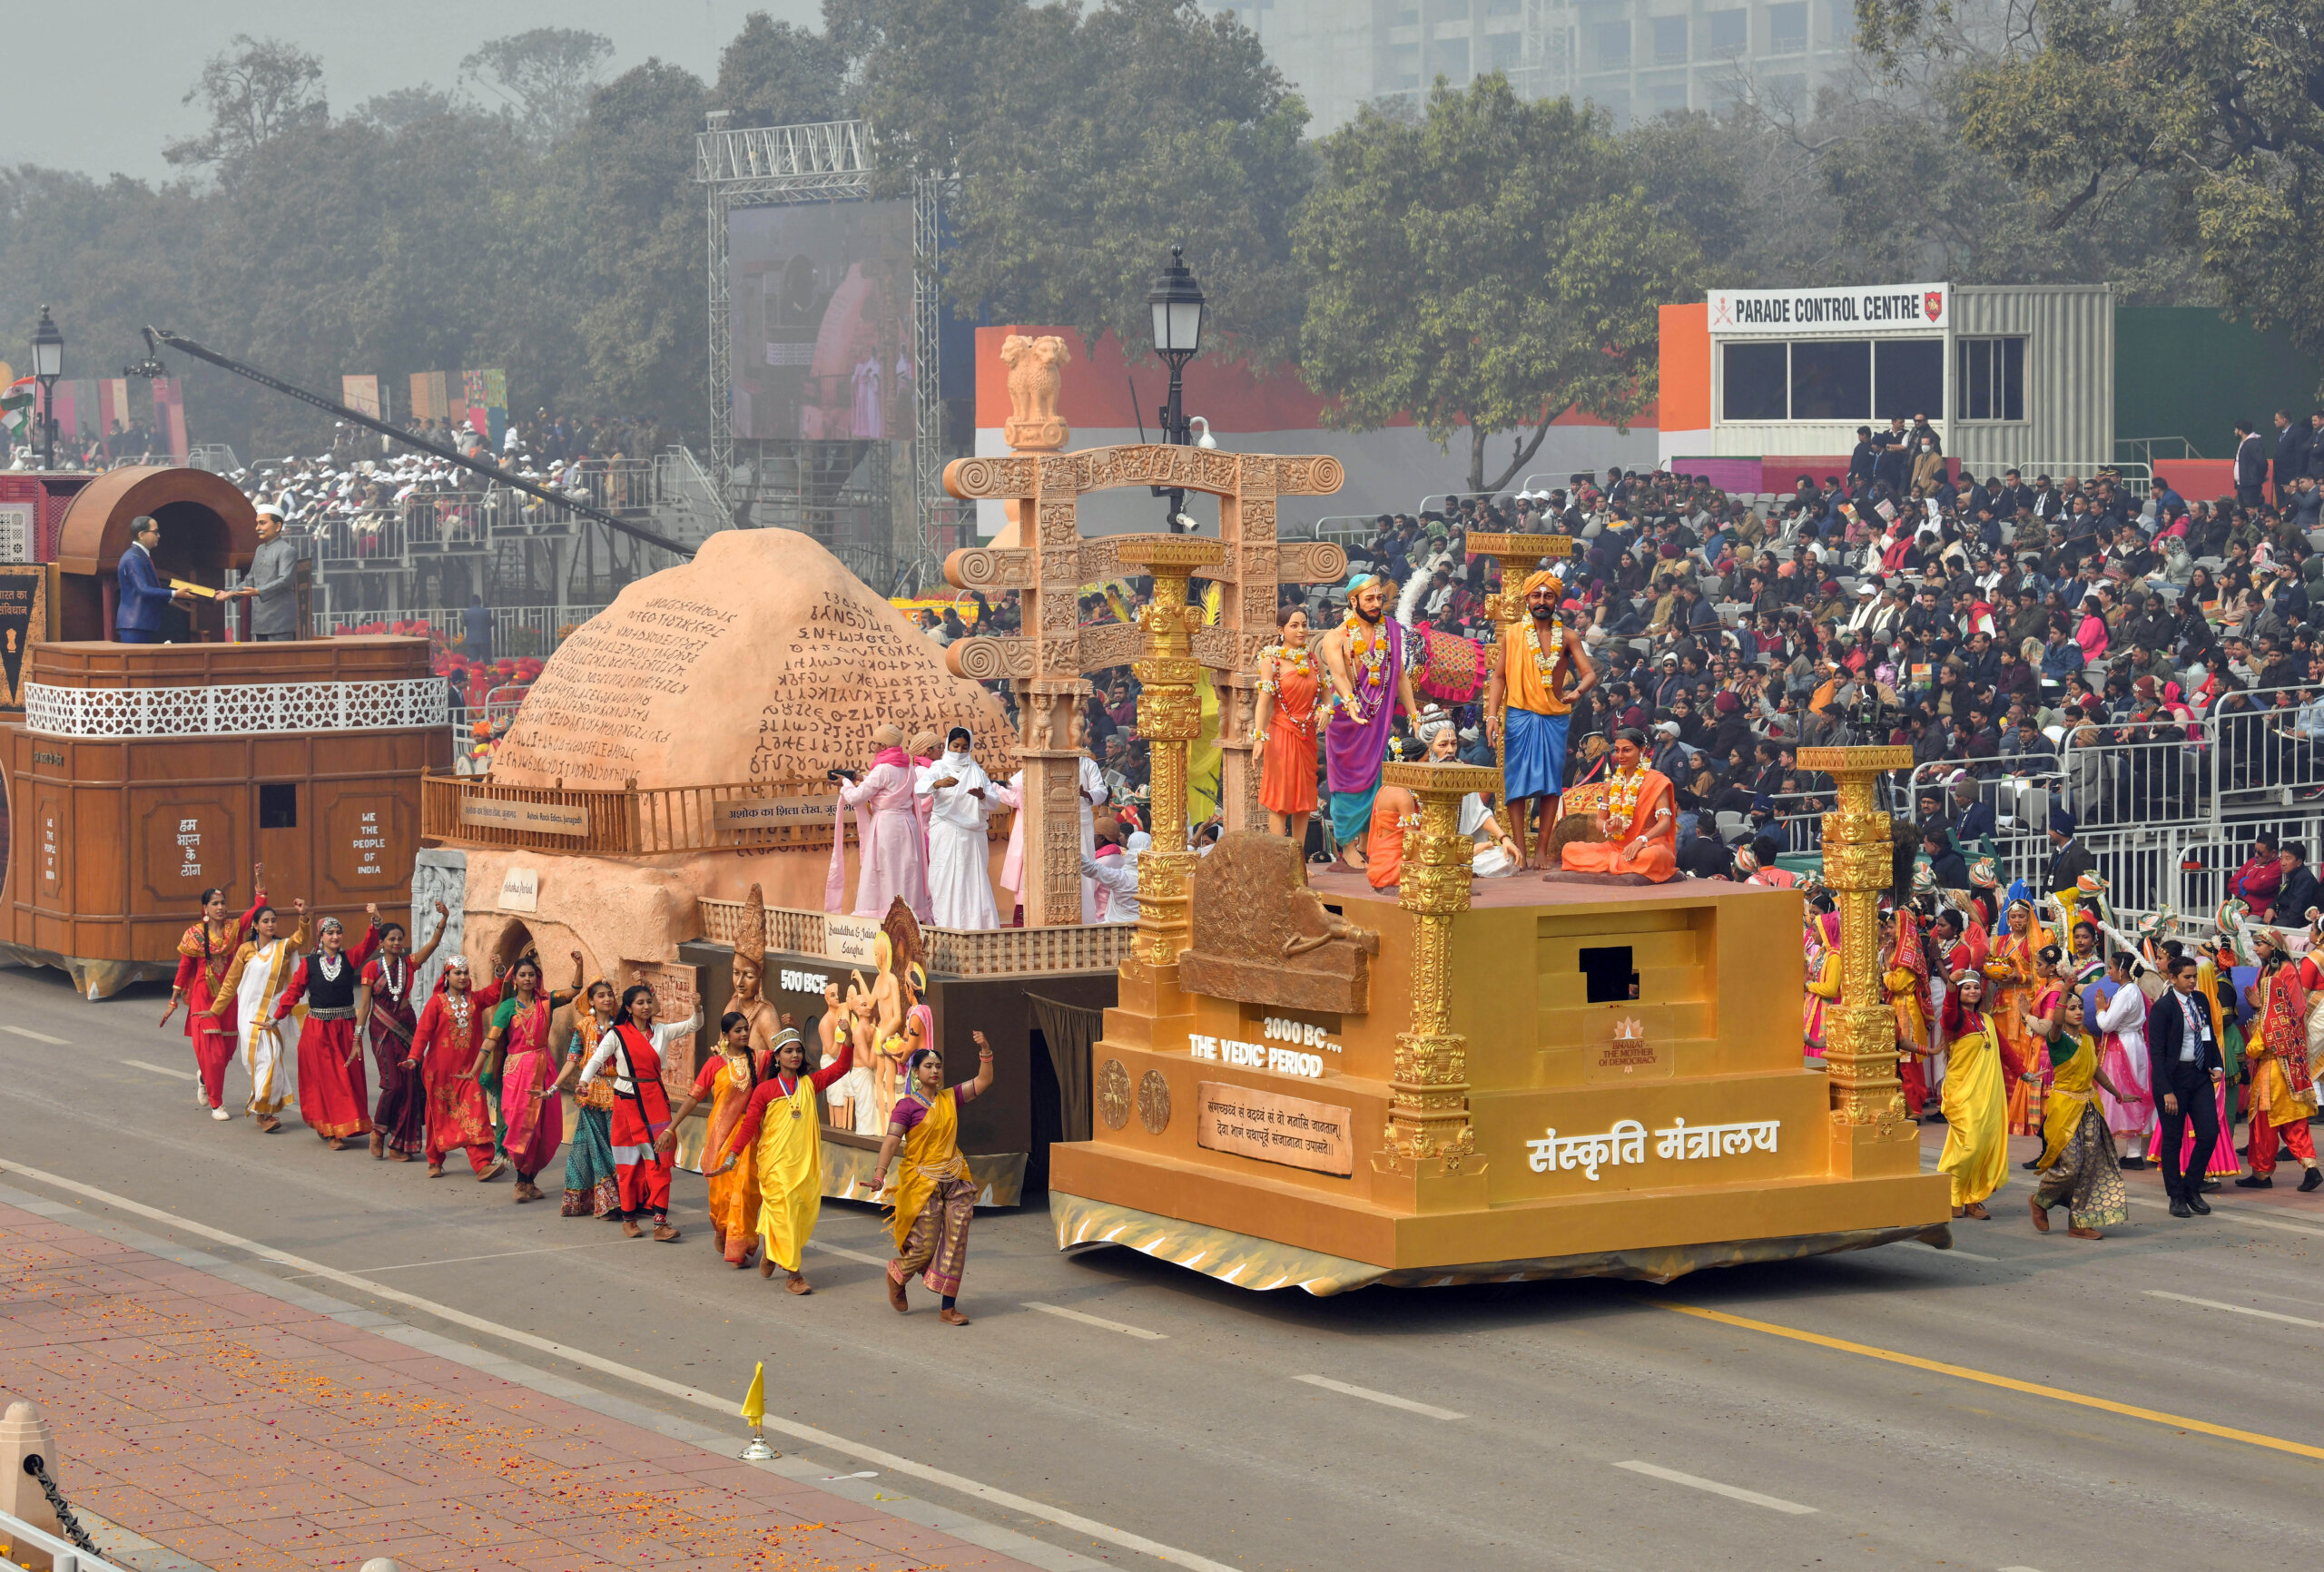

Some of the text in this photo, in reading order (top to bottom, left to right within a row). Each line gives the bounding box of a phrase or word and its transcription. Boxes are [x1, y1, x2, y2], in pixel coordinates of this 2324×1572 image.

[1736, 294, 1920, 323] PARADE CONTROL CENTRE
[16, 590, 27, 600] का
[361, 811, 376, 822] WE
[728, 807, 759, 819] अशोक
[761, 807, 773, 817] का
[775, 804, 800, 817] शिला
[179, 819, 198, 832] हम
[360, 825, 379, 835] THE
[176, 833, 202, 846] भारत
[352, 838, 386, 849] PEOPLE
[185, 846, 197, 861] के
[364, 852, 376, 862] OF
[181, 860, 202, 877] लोग
[357, 865, 381, 874] INDIA
[828, 920, 855, 937] Bauddha
[855, 926, 860, 938] &
[842, 940, 864, 959] Sangha
[781, 968, 828, 995] 500 BCE
[1264, 1017, 1304, 1044] 3000
[1188, 1033, 1324, 1078] THE VEDIC PERIOD
[1602, 1047, 1654, 1058] THE MOTHER
[1609, 1056, 1658, 1066] DEMOCRACY
[1238, 1103, 1245, 1118] सं
[1246, 1106, 1265, 1123] वदध्वं
[1267, 1108, 1275, 1124] सं
[1276, 1110, 1285, 1125] वो
[1286, 1113, 1309, 1130] मनांसि
[1216, 1119, 1228, 1136] देवा
[1230, 1123, 1245, 1138] भागं
[1526, 1117, 1780, 1181] संस्कृति मंत्रालय
